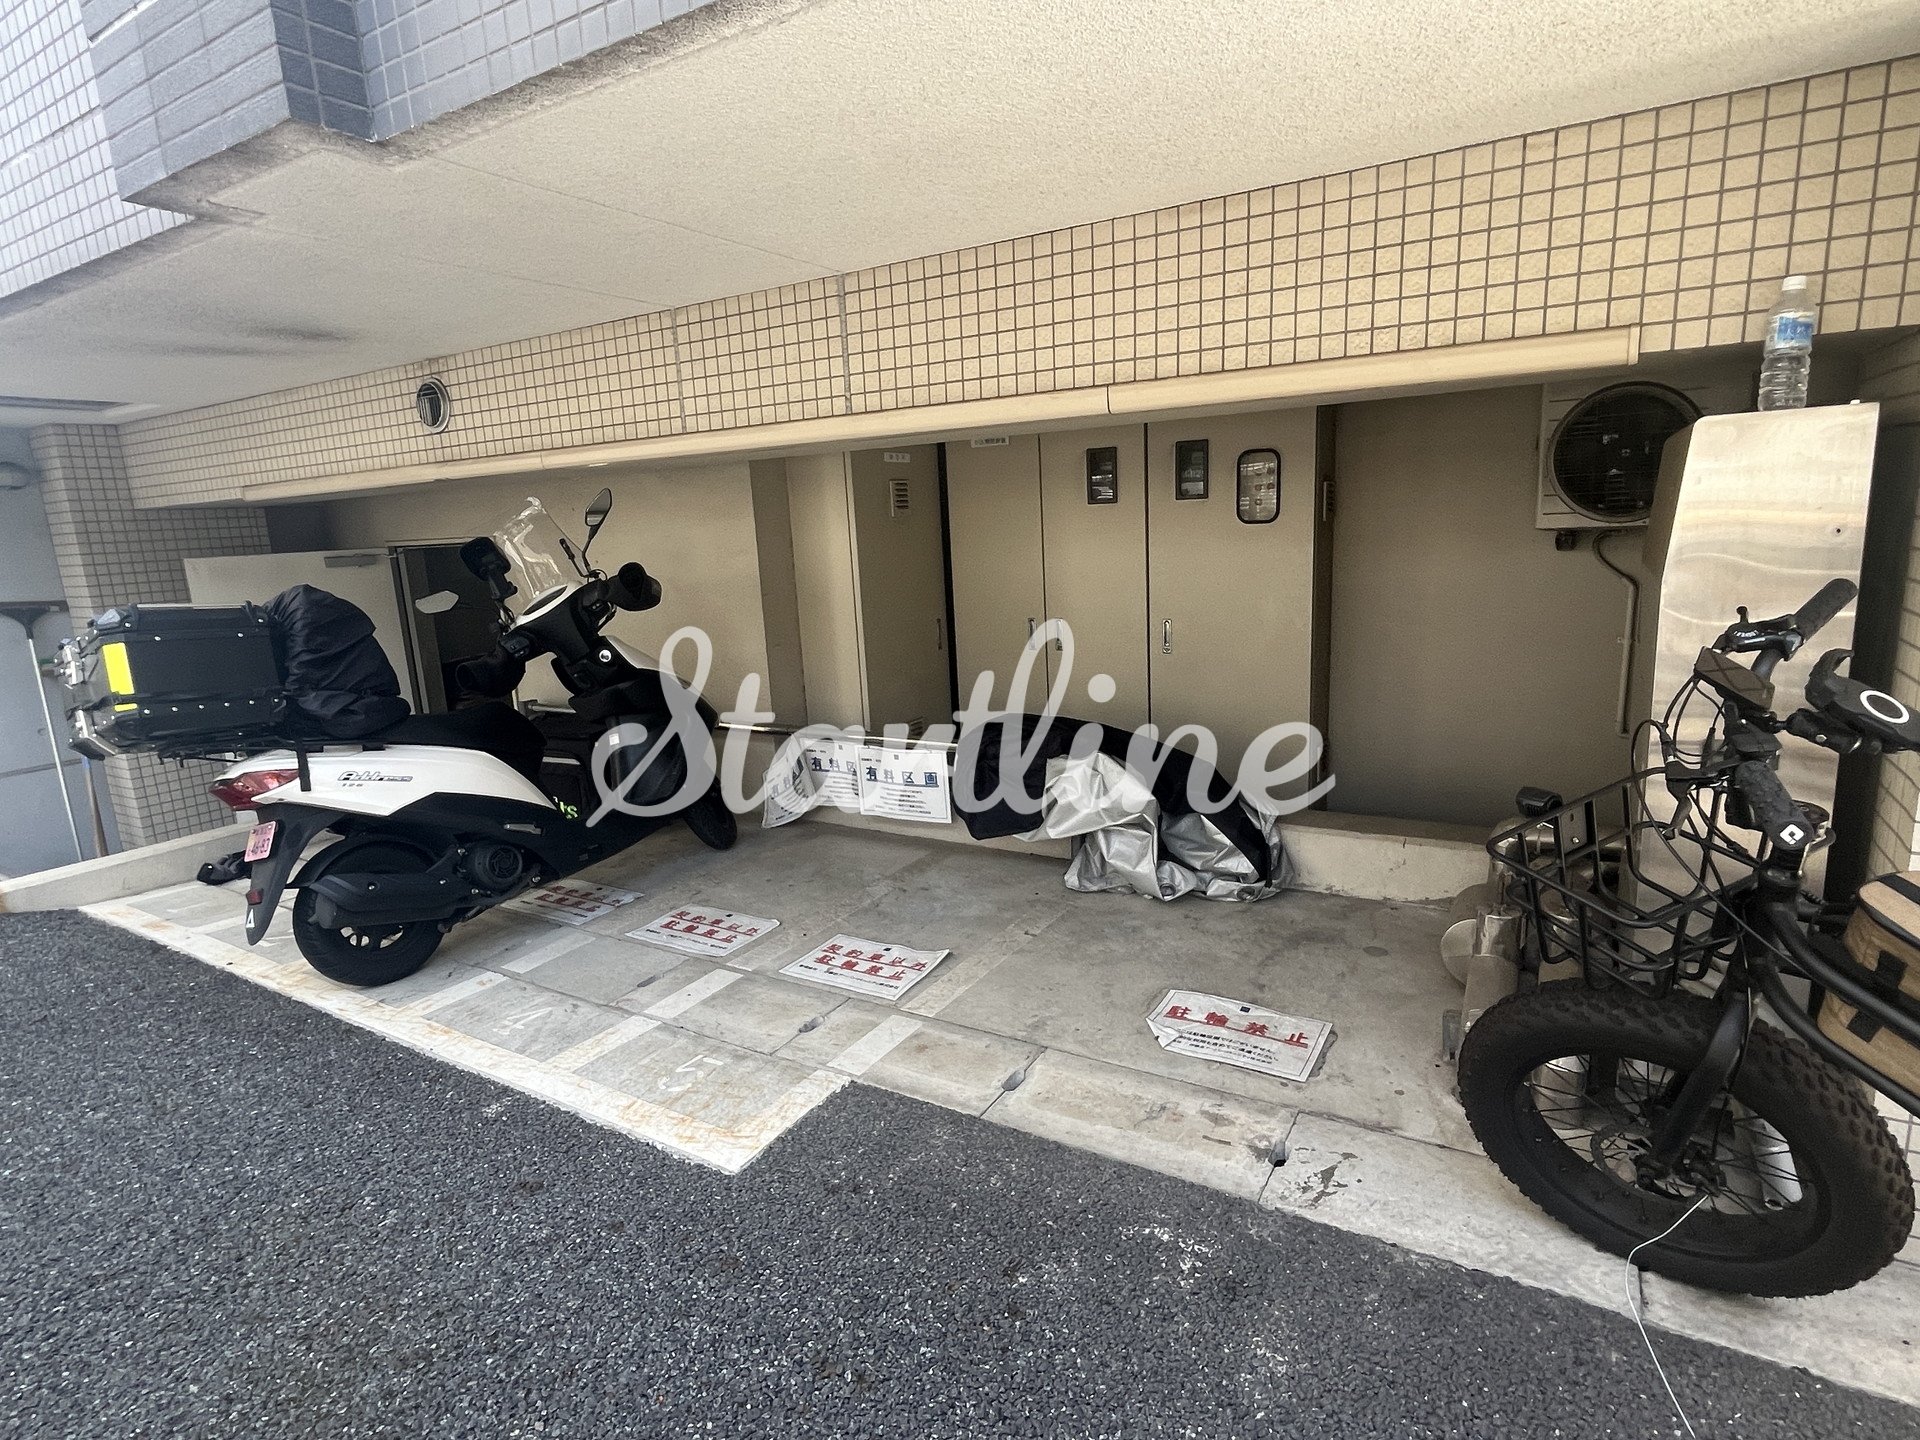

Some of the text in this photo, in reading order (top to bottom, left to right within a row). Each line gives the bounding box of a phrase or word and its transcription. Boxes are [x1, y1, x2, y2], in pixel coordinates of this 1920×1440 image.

[866, 765, 938, 786] 有料区画
[814, 954, 907, 980] 駐輪禁止
[1164, 1005, 1309, 1048] 駐輪禁止
